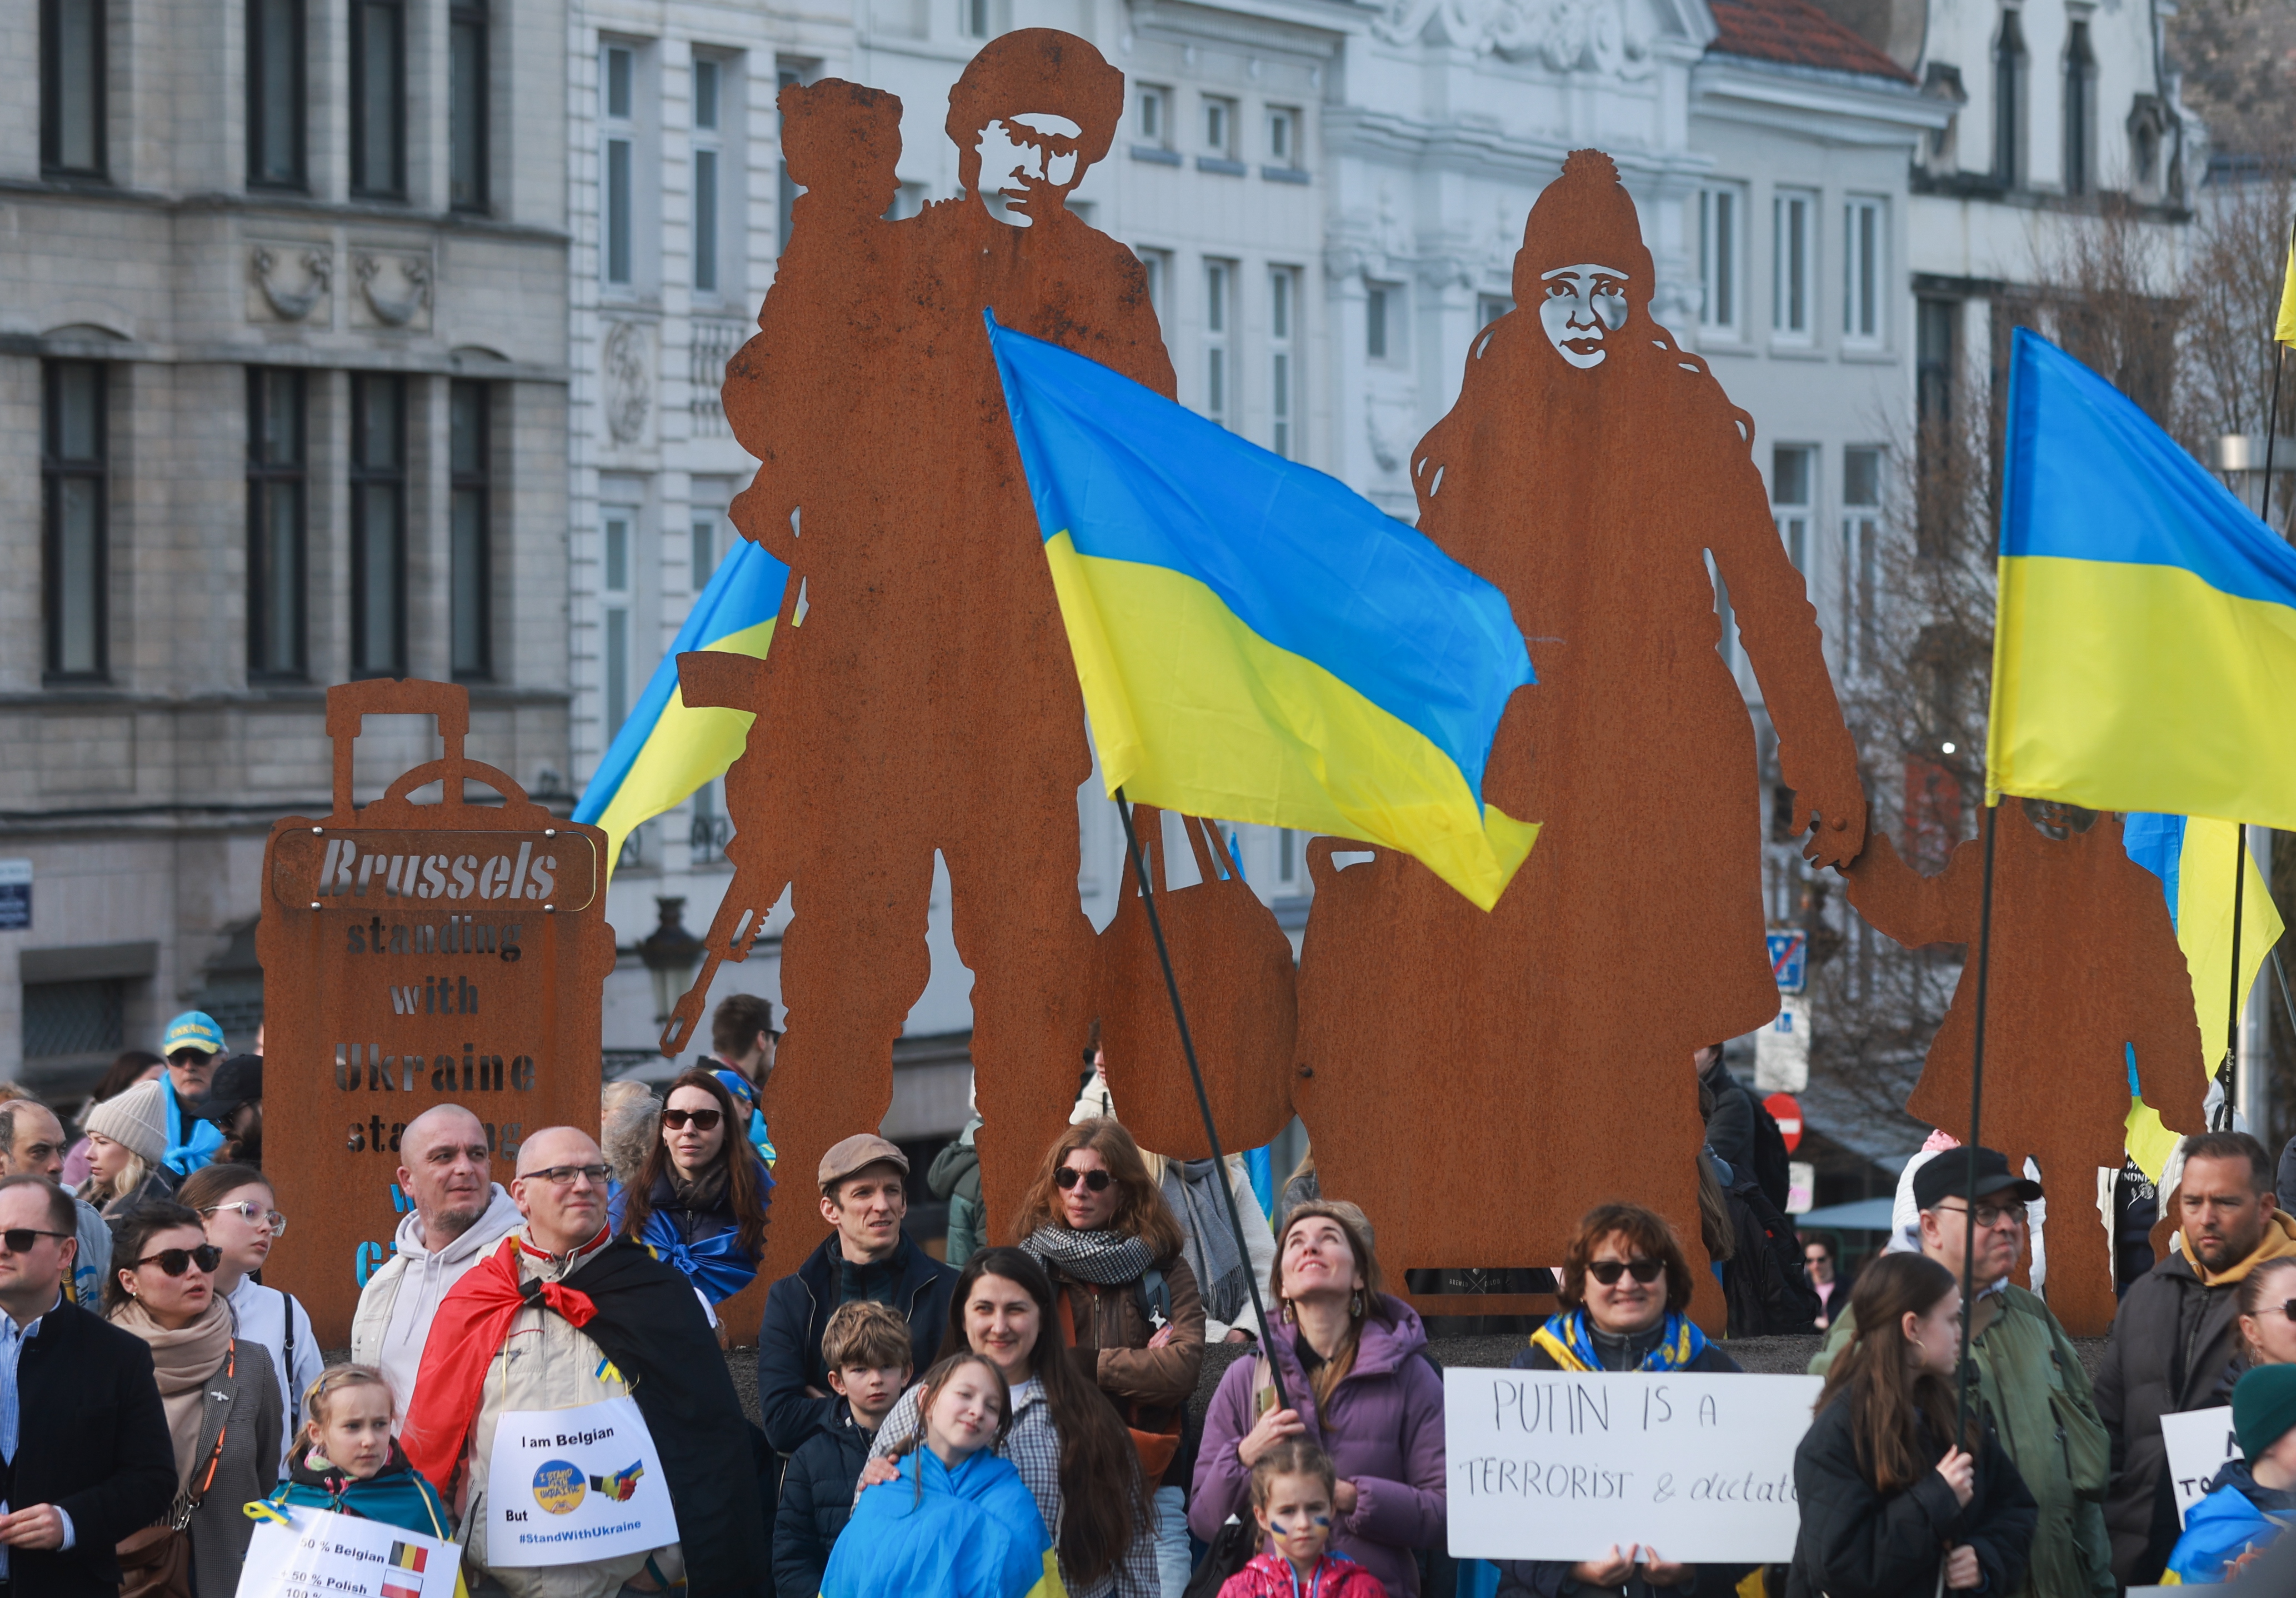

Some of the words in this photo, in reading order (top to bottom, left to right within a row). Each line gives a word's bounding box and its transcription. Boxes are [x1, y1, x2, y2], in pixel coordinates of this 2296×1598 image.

[317, 840, 556, 900] Brussels
[347, 916, 522, 962] standing
[390, 976, 478, 1015] with
[336, 1043, 536, 1092] Ukraine
[1493, 1379, 1608, 1436] PUTIN
[1643, 1384, 1672, 1432] IS
[1699, 1394, 1717, 1427] A
[522, 1436, 526, 1448] I
[530, 1439, 551, 1448] am
[556, 1427, 614, 1446] Belgian
[1653, 1472, 1676, 1504] &
[506, 1510, 528, 1521] But
[519, 1520, 641, 1544] #StandWithUkraine
[301, 1537, 315, 1549] 50
[320, 1541, 330, 1552] %
[334, 1544, 384, 1564] Belgian
[292, 1570, 307, 1582] 50
[311, 1574, 322, 1586] %
[327, 1577, 367, 1595] Polish
